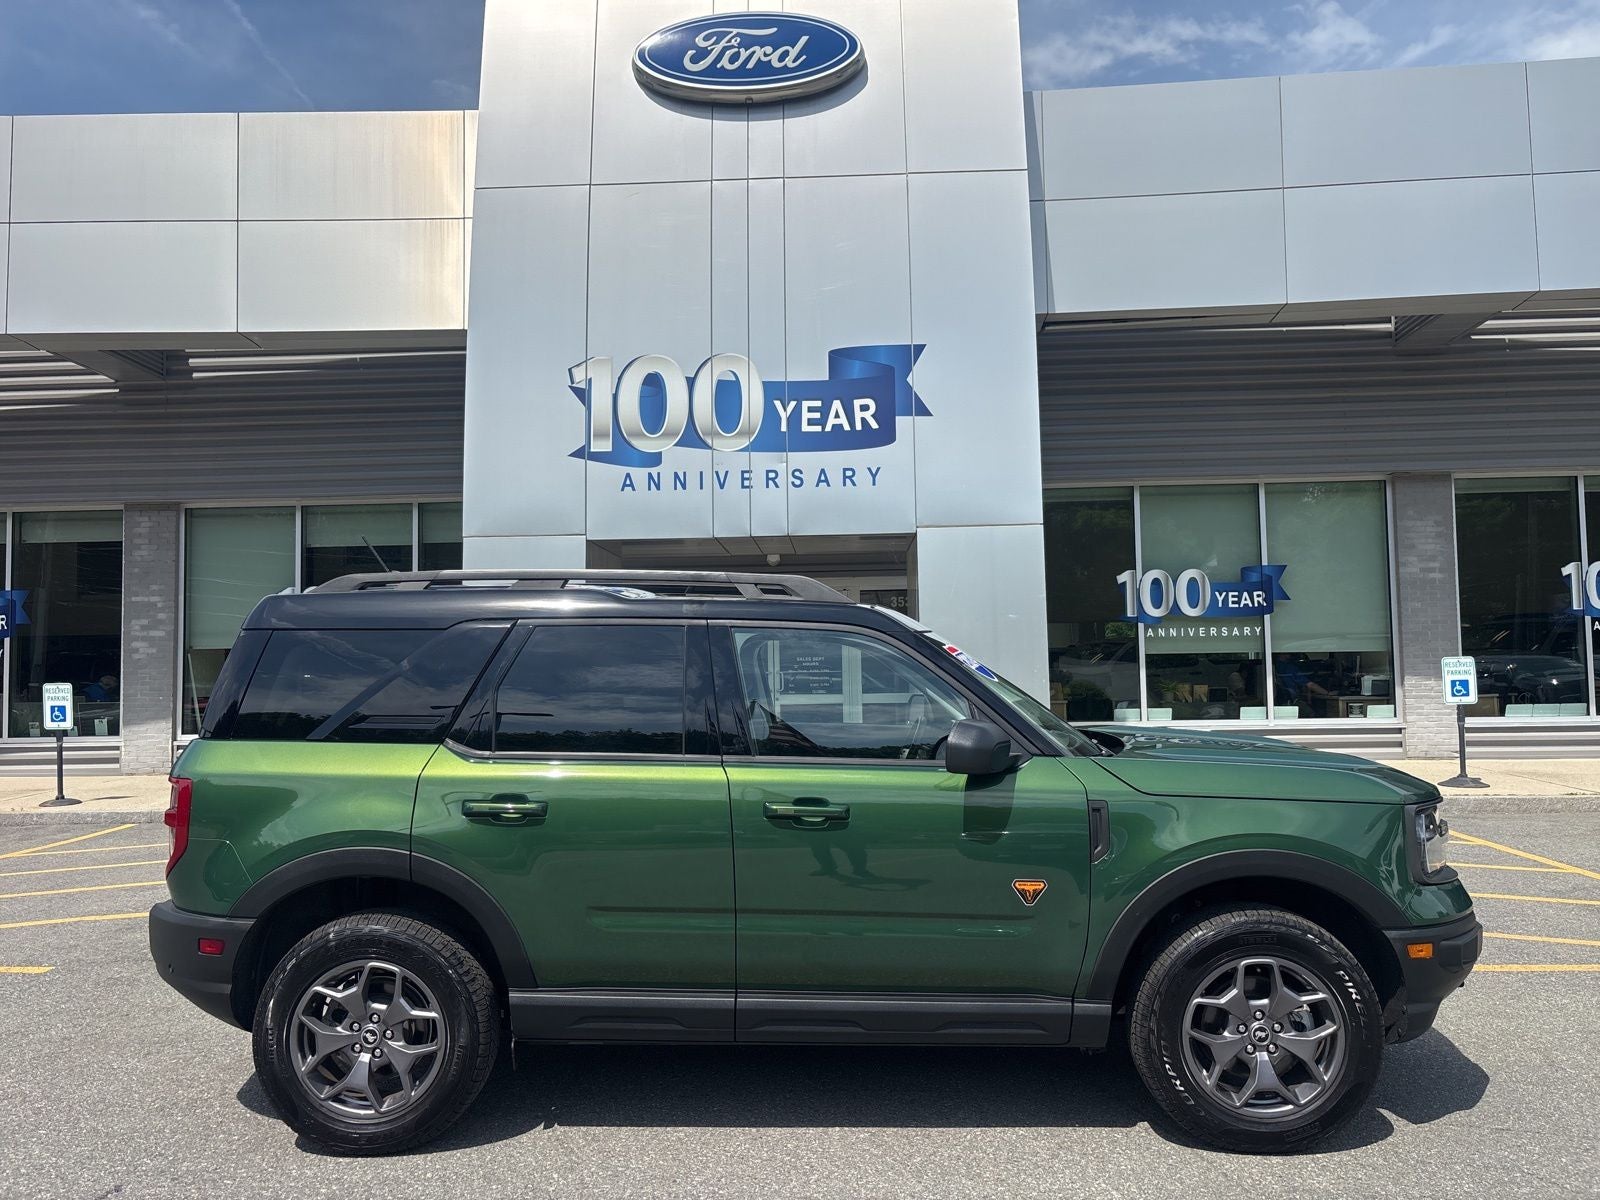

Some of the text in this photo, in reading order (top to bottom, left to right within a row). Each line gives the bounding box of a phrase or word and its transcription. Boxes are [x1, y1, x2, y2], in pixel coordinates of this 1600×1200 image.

[683, 27, 809, 72] Ford
[568, 353, 880, 453] 100 YEAR
[620, 466, 882, 492] ANNIVERSARY
[890, 596, 907, 608] 35
[1116, 568, 1267, 617] 100 YEAR
[1147, 626, 1262, 638] ANNIVERSARY
[1444, 661, 1474, 669] RESERVED
[45, 687, 70, 695] RESERVED
